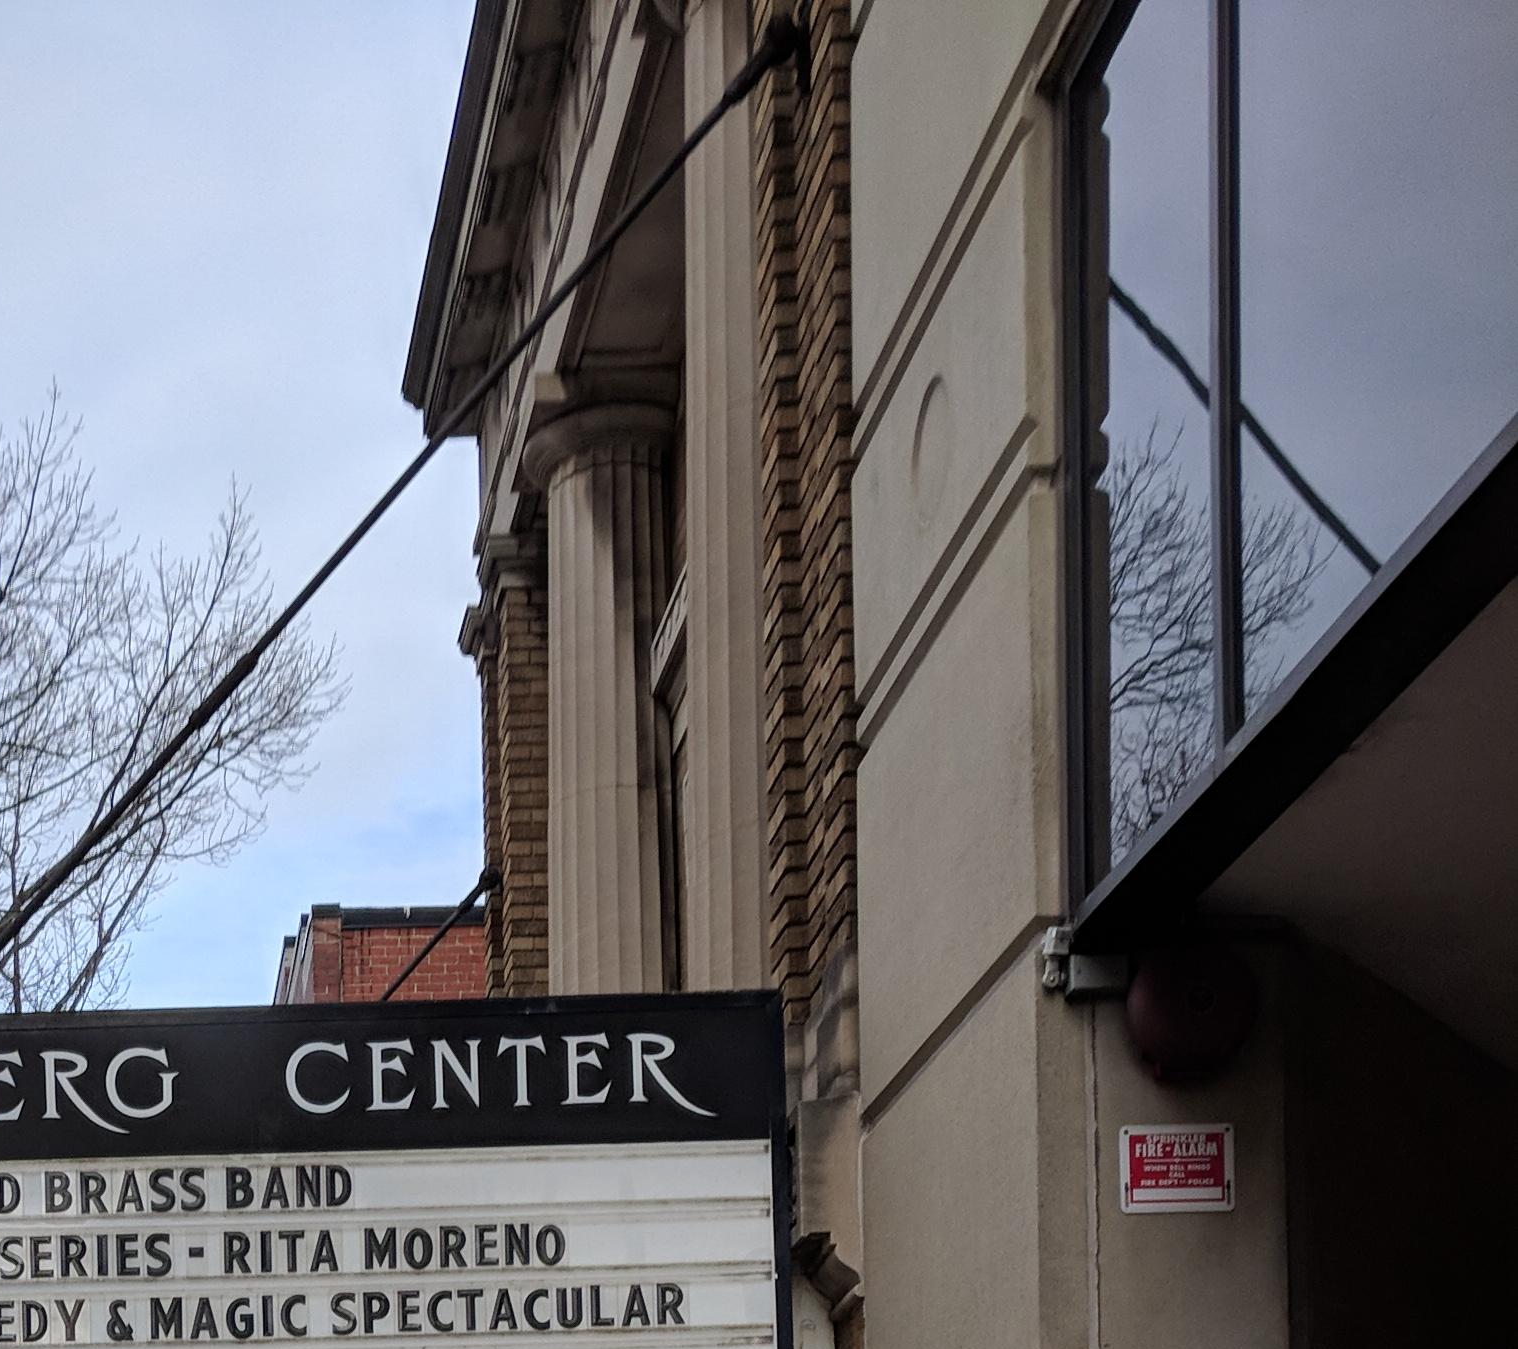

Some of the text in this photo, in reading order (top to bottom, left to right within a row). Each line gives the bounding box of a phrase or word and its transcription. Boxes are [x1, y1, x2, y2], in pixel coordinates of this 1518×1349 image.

[284, 1031, 719, 1118] CENTER
[44, 1166, 206, 1212] BRASS
[225, 1164, 352, 1207] BAND
[223, 1229, 338, 1274] RITA
[363, 1222, 566, 1271] MORENO
[106, 1298, 134, 1341] &
[150, 1293, 308, 1340] MAGIC
[330, 1281, 685, 1335] SPECTACULAR
